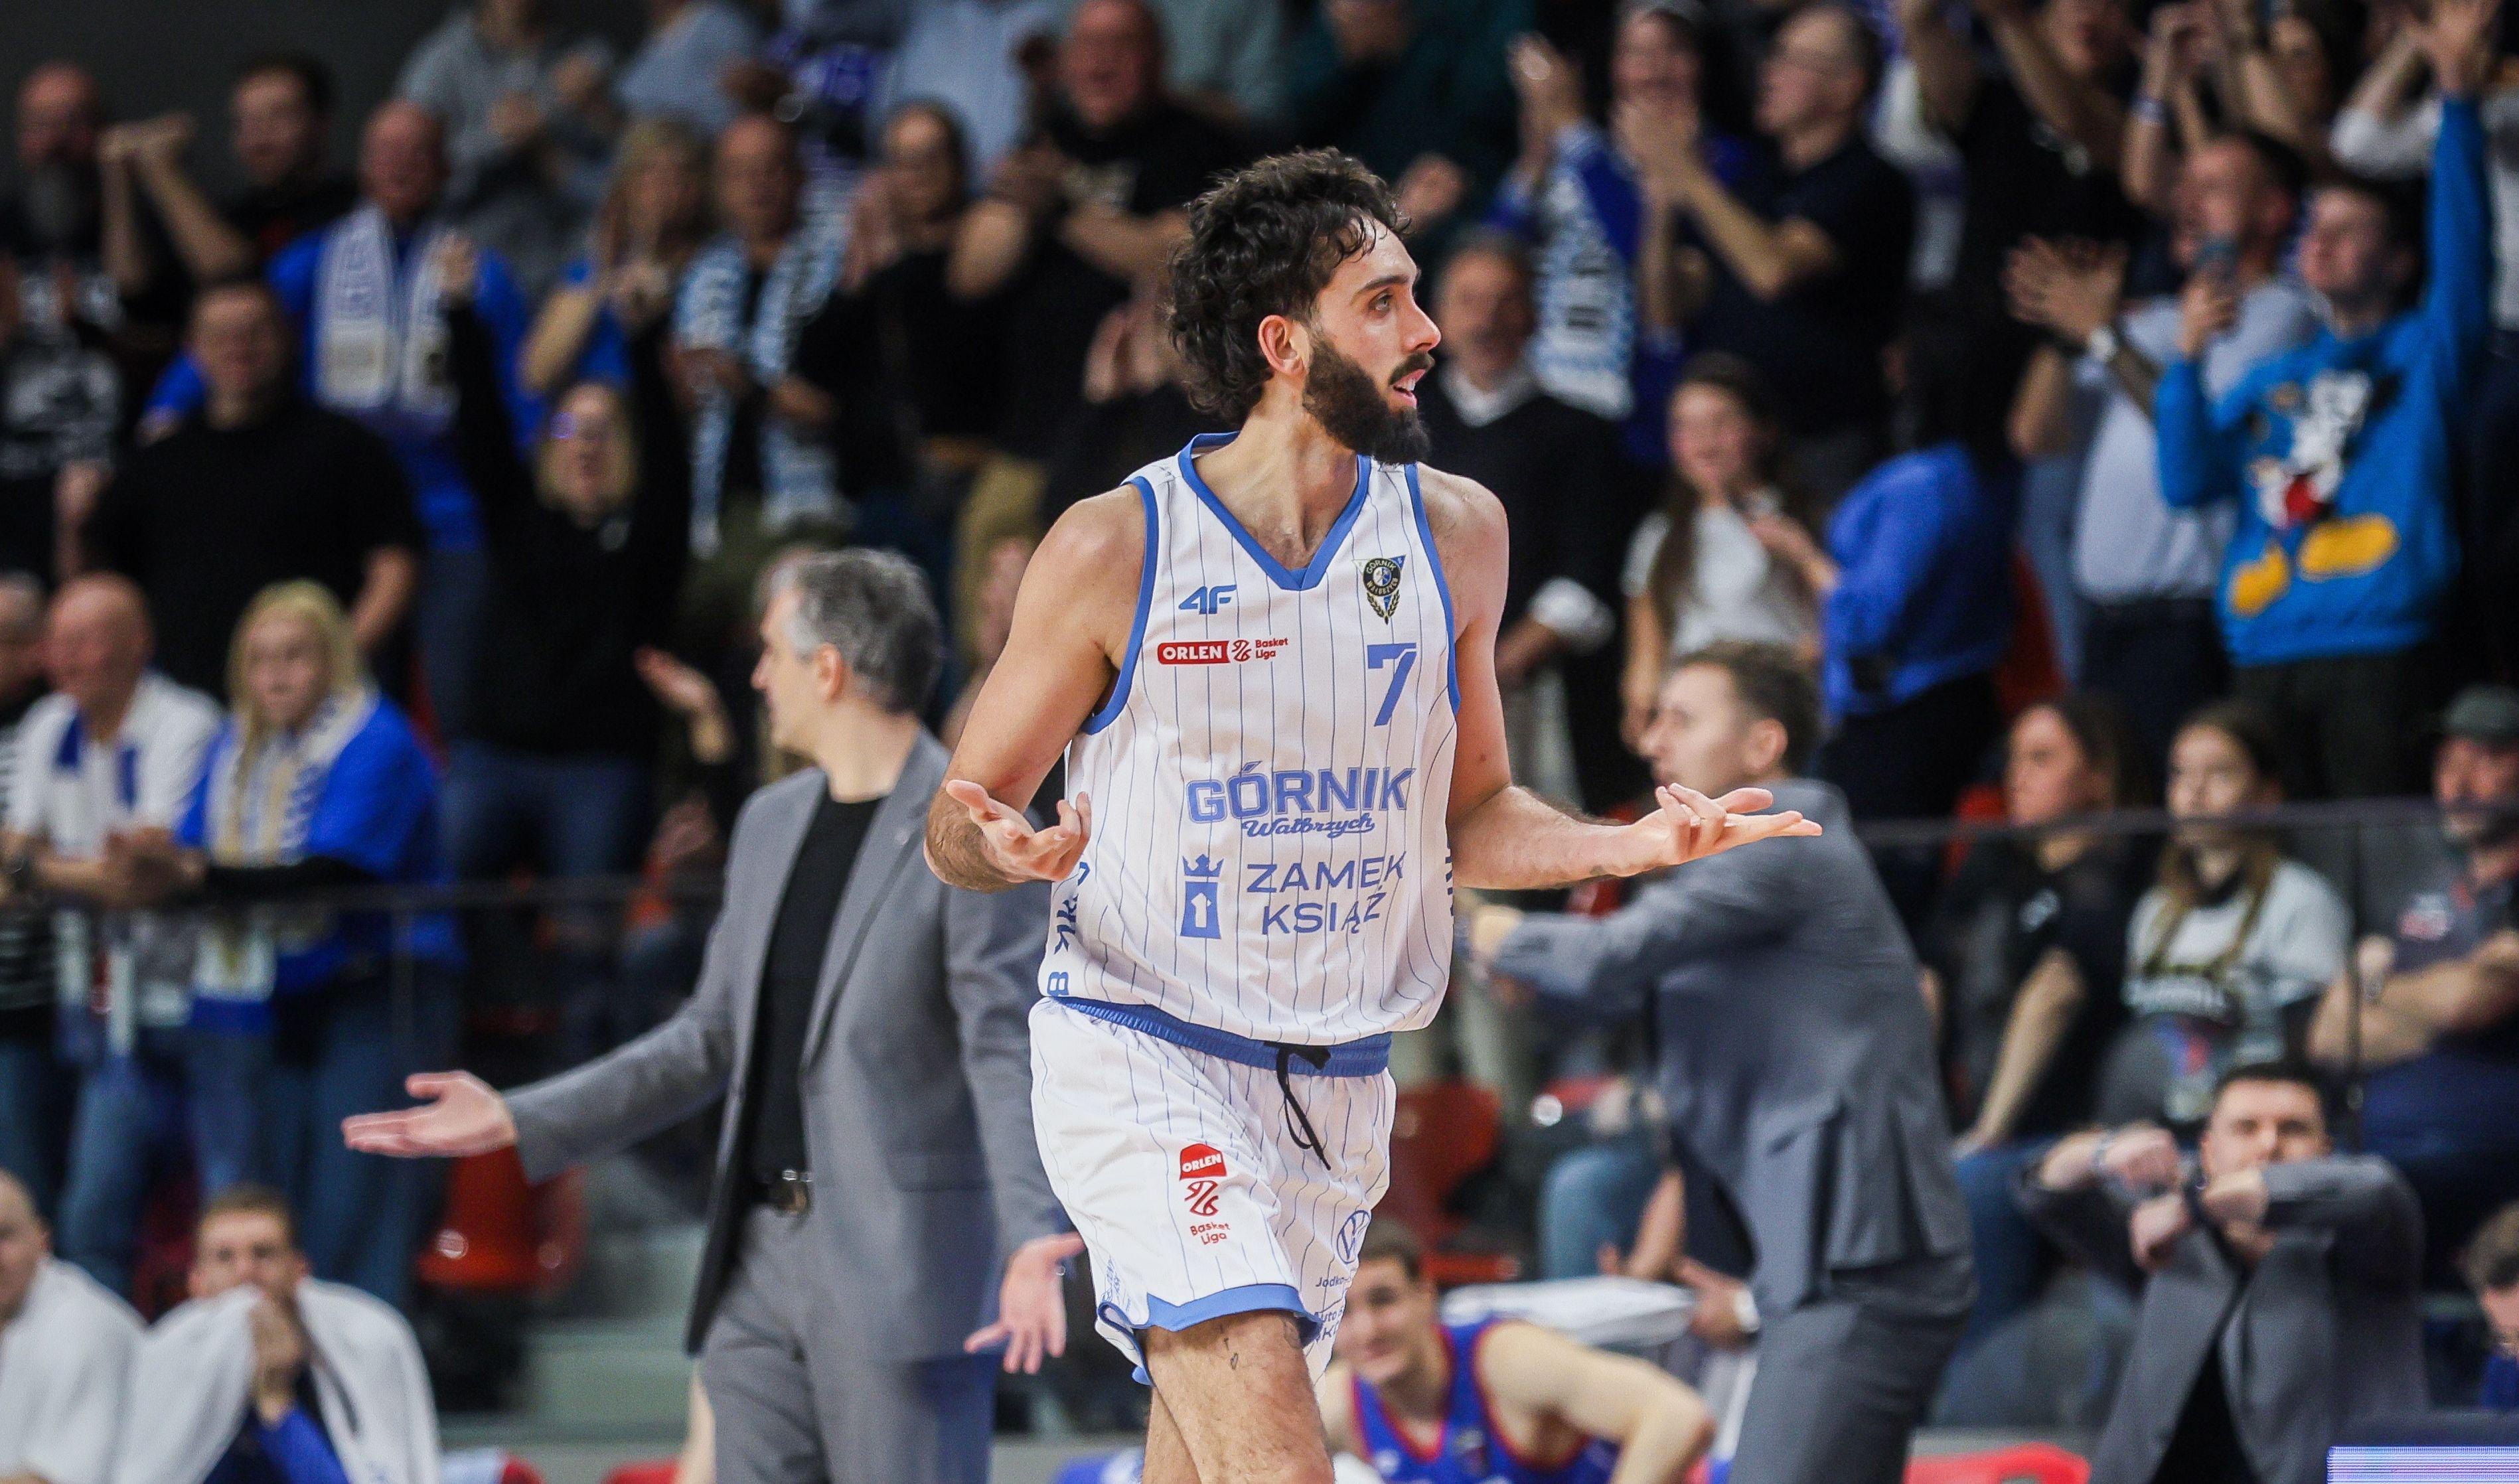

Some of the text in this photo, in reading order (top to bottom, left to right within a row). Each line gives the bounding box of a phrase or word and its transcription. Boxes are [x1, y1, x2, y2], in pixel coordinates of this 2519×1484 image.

[1178, 585, 1237, 615] 4F
[1255, 637, 1288, 648] Basket
[1162, 645, 1222, 660] ORLEN
[1256, 649, 1276, 660] Liga
[1367, 642, 1416, 727] 7
[1185, 761, 1416, 824] GÓRNIK
[1247, 851, 1407, 893] ZAMEK
[1182, 1153, 1223, 1173] ORLEN
[1190, 1221, 1231, 1236] Basket
[1201, 1232, 1227, 1245] Liga
